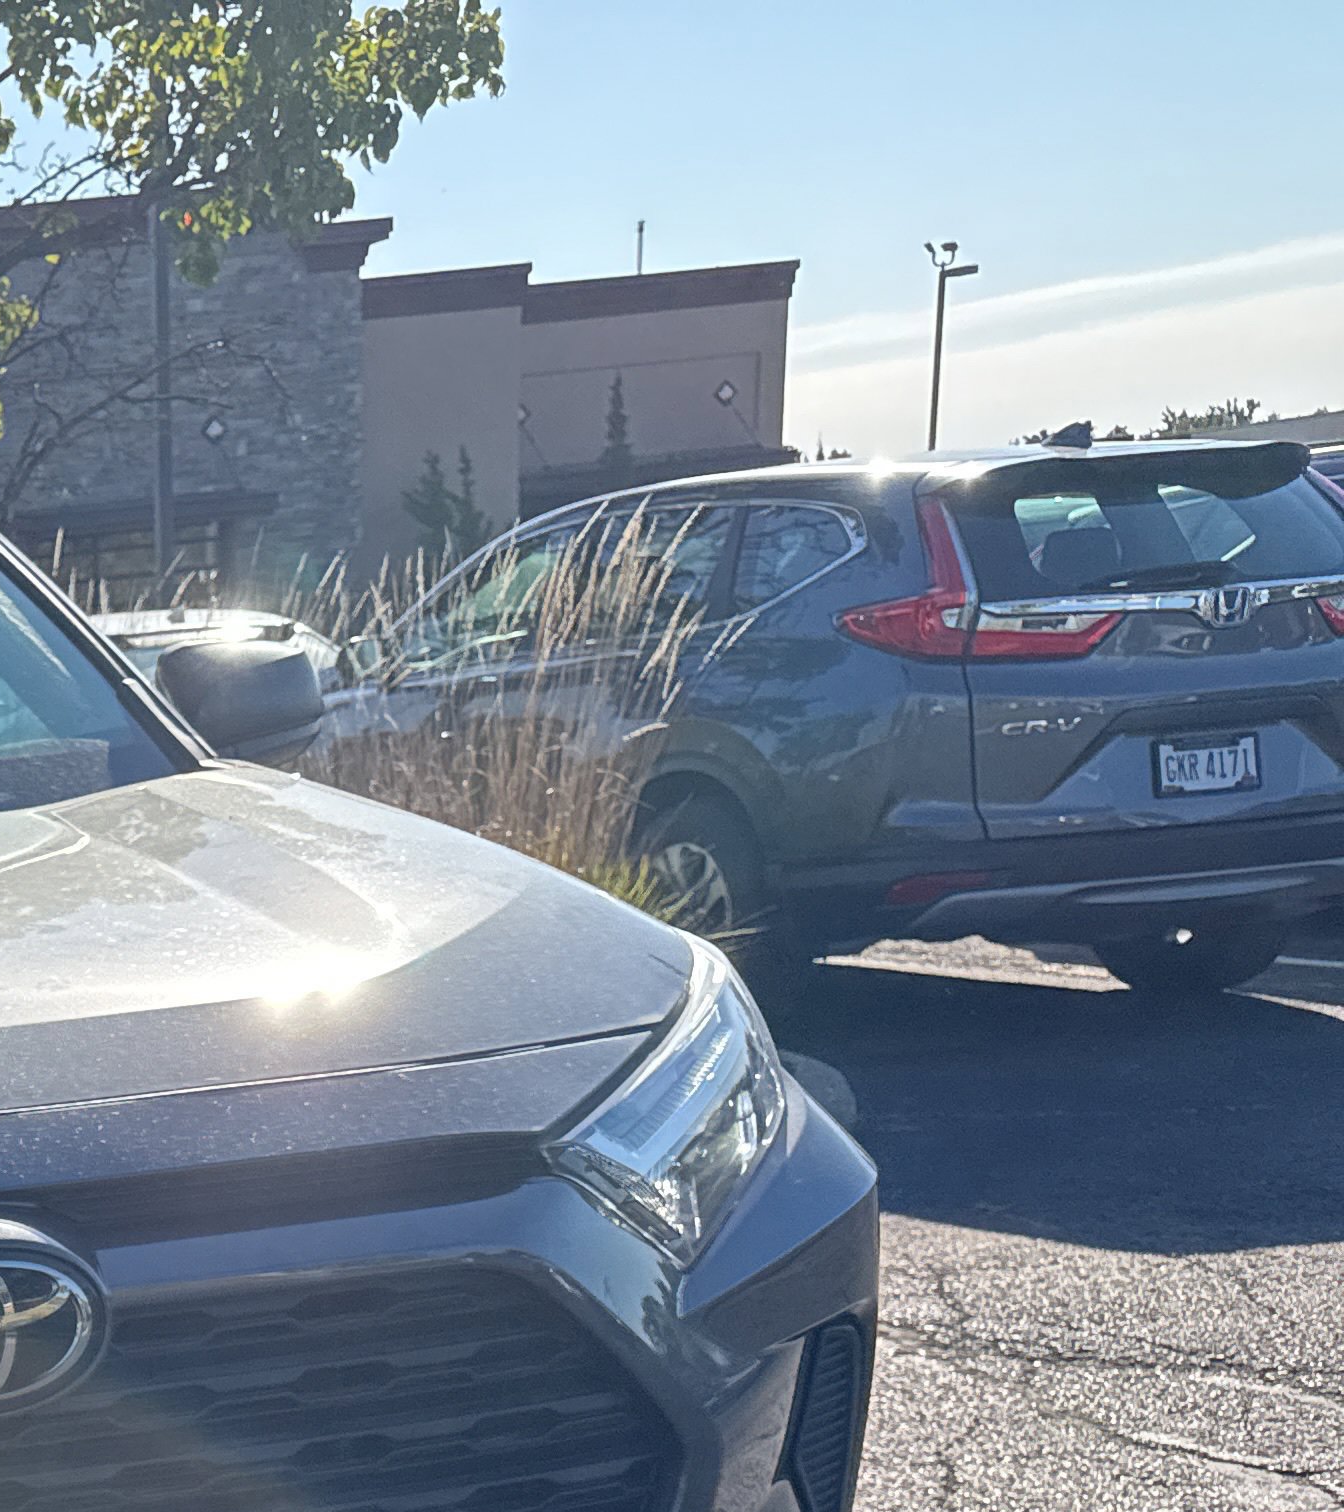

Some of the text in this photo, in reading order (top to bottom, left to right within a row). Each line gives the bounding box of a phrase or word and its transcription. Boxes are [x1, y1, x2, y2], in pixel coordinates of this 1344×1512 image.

[1001, 716, 1082, 736] CR-V
[1165, 747, 1251, 783] GKR 4171
